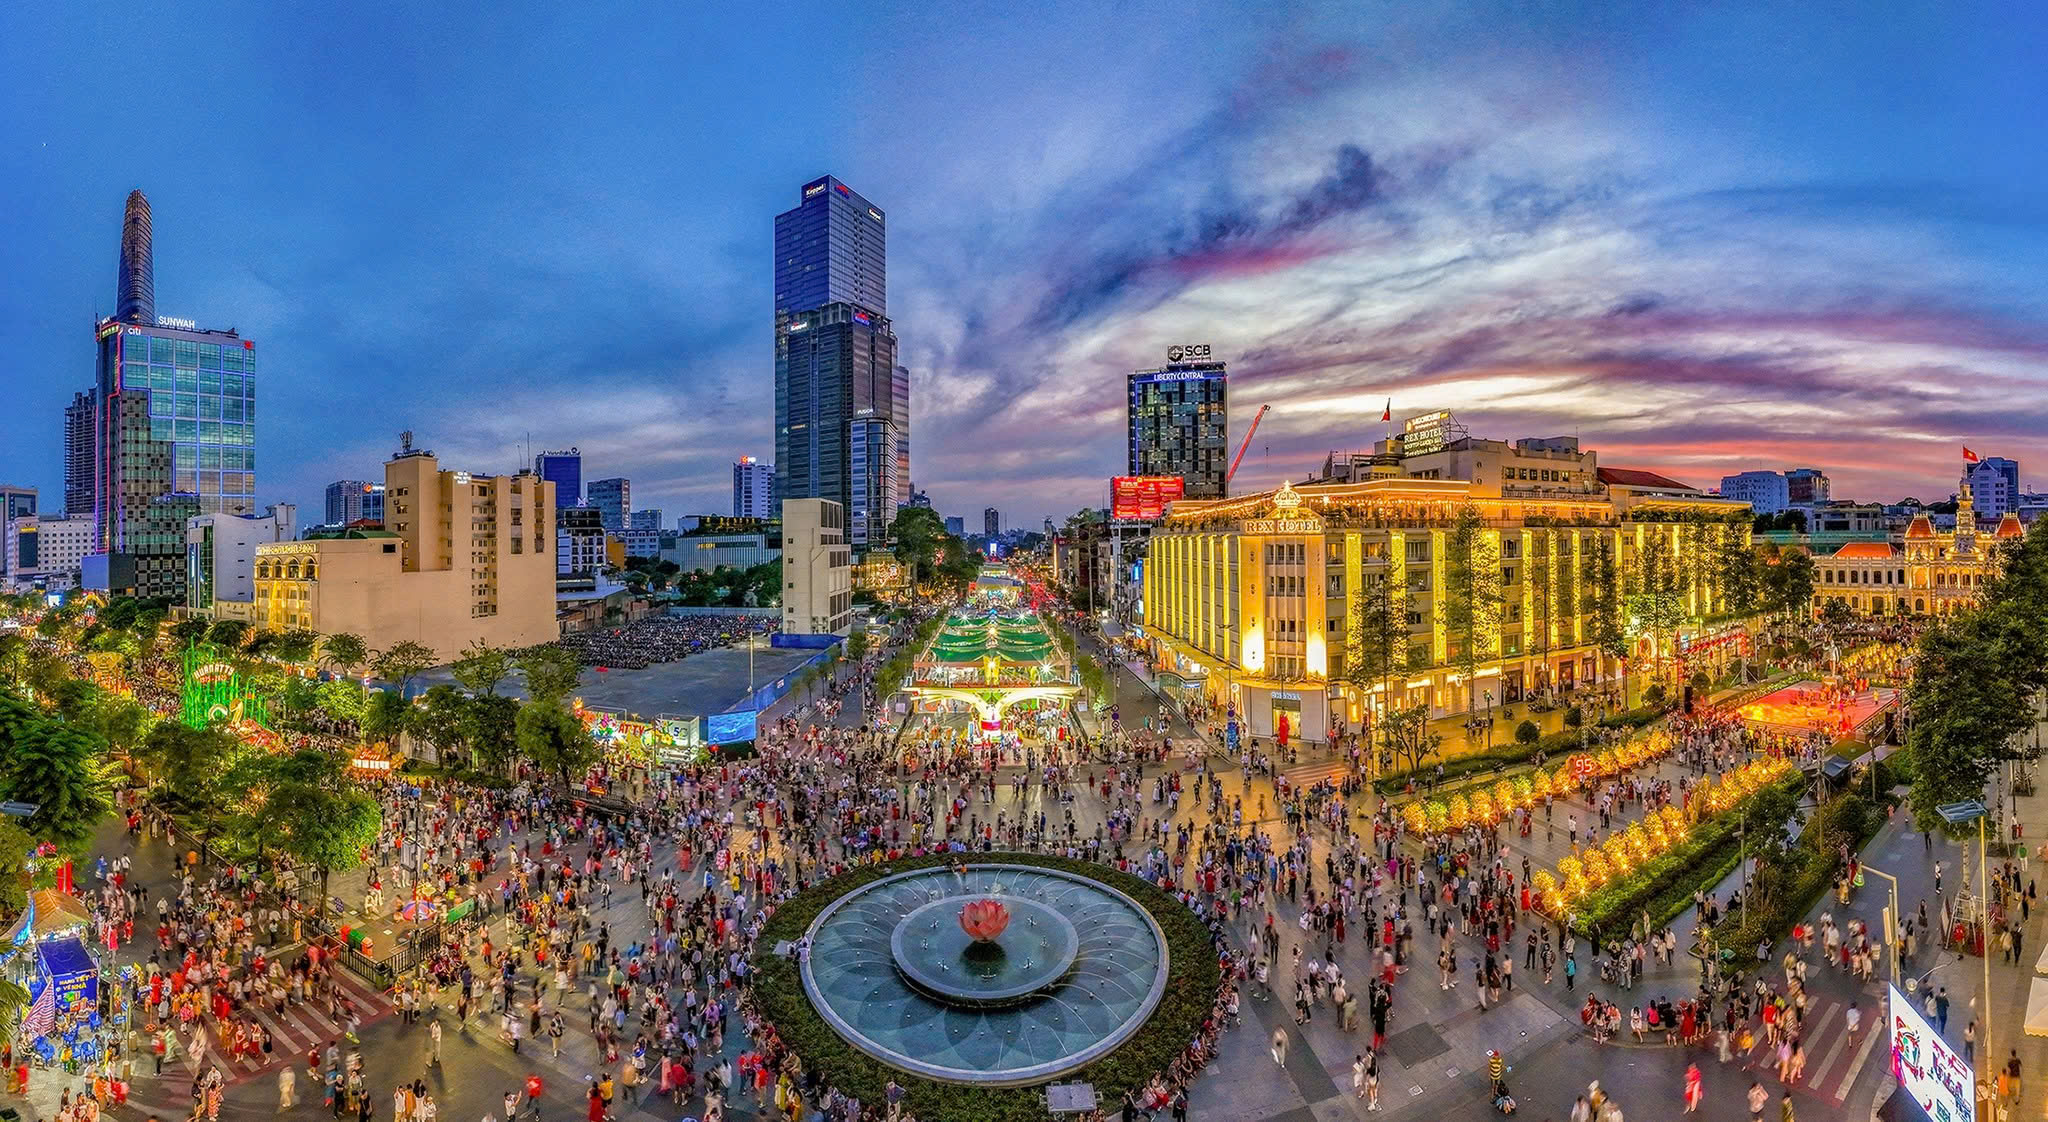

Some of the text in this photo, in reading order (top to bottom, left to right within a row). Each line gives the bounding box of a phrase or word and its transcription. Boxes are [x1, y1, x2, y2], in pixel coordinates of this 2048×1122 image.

[158, 315, 196, 329] SUNWAH
[127, 326, 142, 336] citi
[1184, 344, 1211, 356] SCB
[1404, 426, 1444, 444] REX HOTEL
[1246, 519, 1321, 533] REX HOTEL
[1575, 758, 1593, 774] 95
